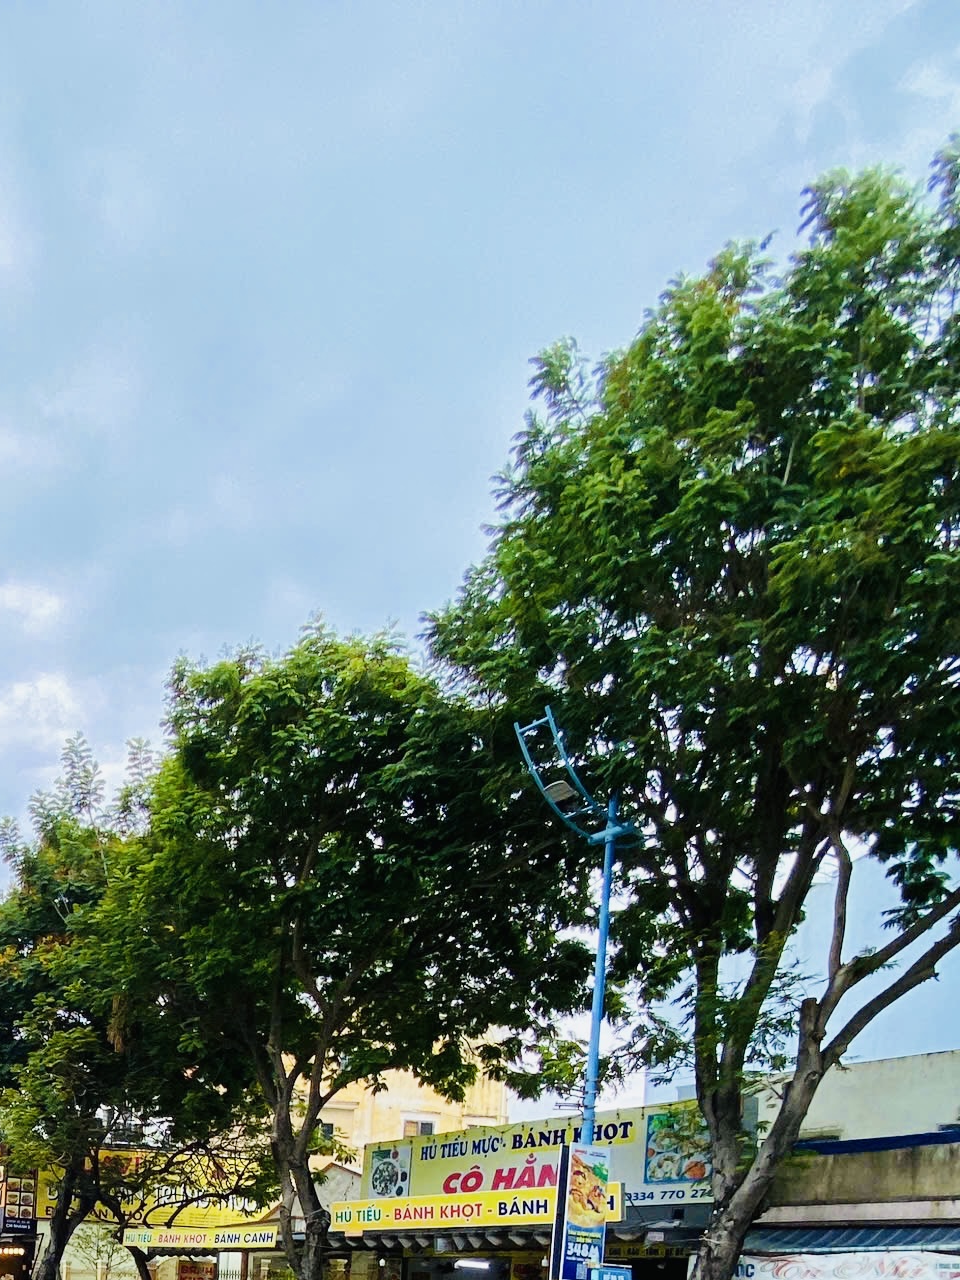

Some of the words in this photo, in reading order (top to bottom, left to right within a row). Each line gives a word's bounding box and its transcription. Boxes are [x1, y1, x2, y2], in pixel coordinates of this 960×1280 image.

[440, 1135, 467, 1158] TIẾU
[512, 1127, 566, 1149] BÁNH
[442, 1164, 483, 1194] CÔ
[660, 1189, 684, 1199] 770
[335, 1206, 352, 1223] HỦ
[356, 1203, 381, 1222] TIẾU
[394, 1203, 434, 1221] BÁNH
[440, 1203, 482, 1222] KHỌT
[498, 1196, 548, 1216] BÁNH
[214, 1231, 240, 1243] BÁNH
[243, 1233, 274, 1244] CANH
